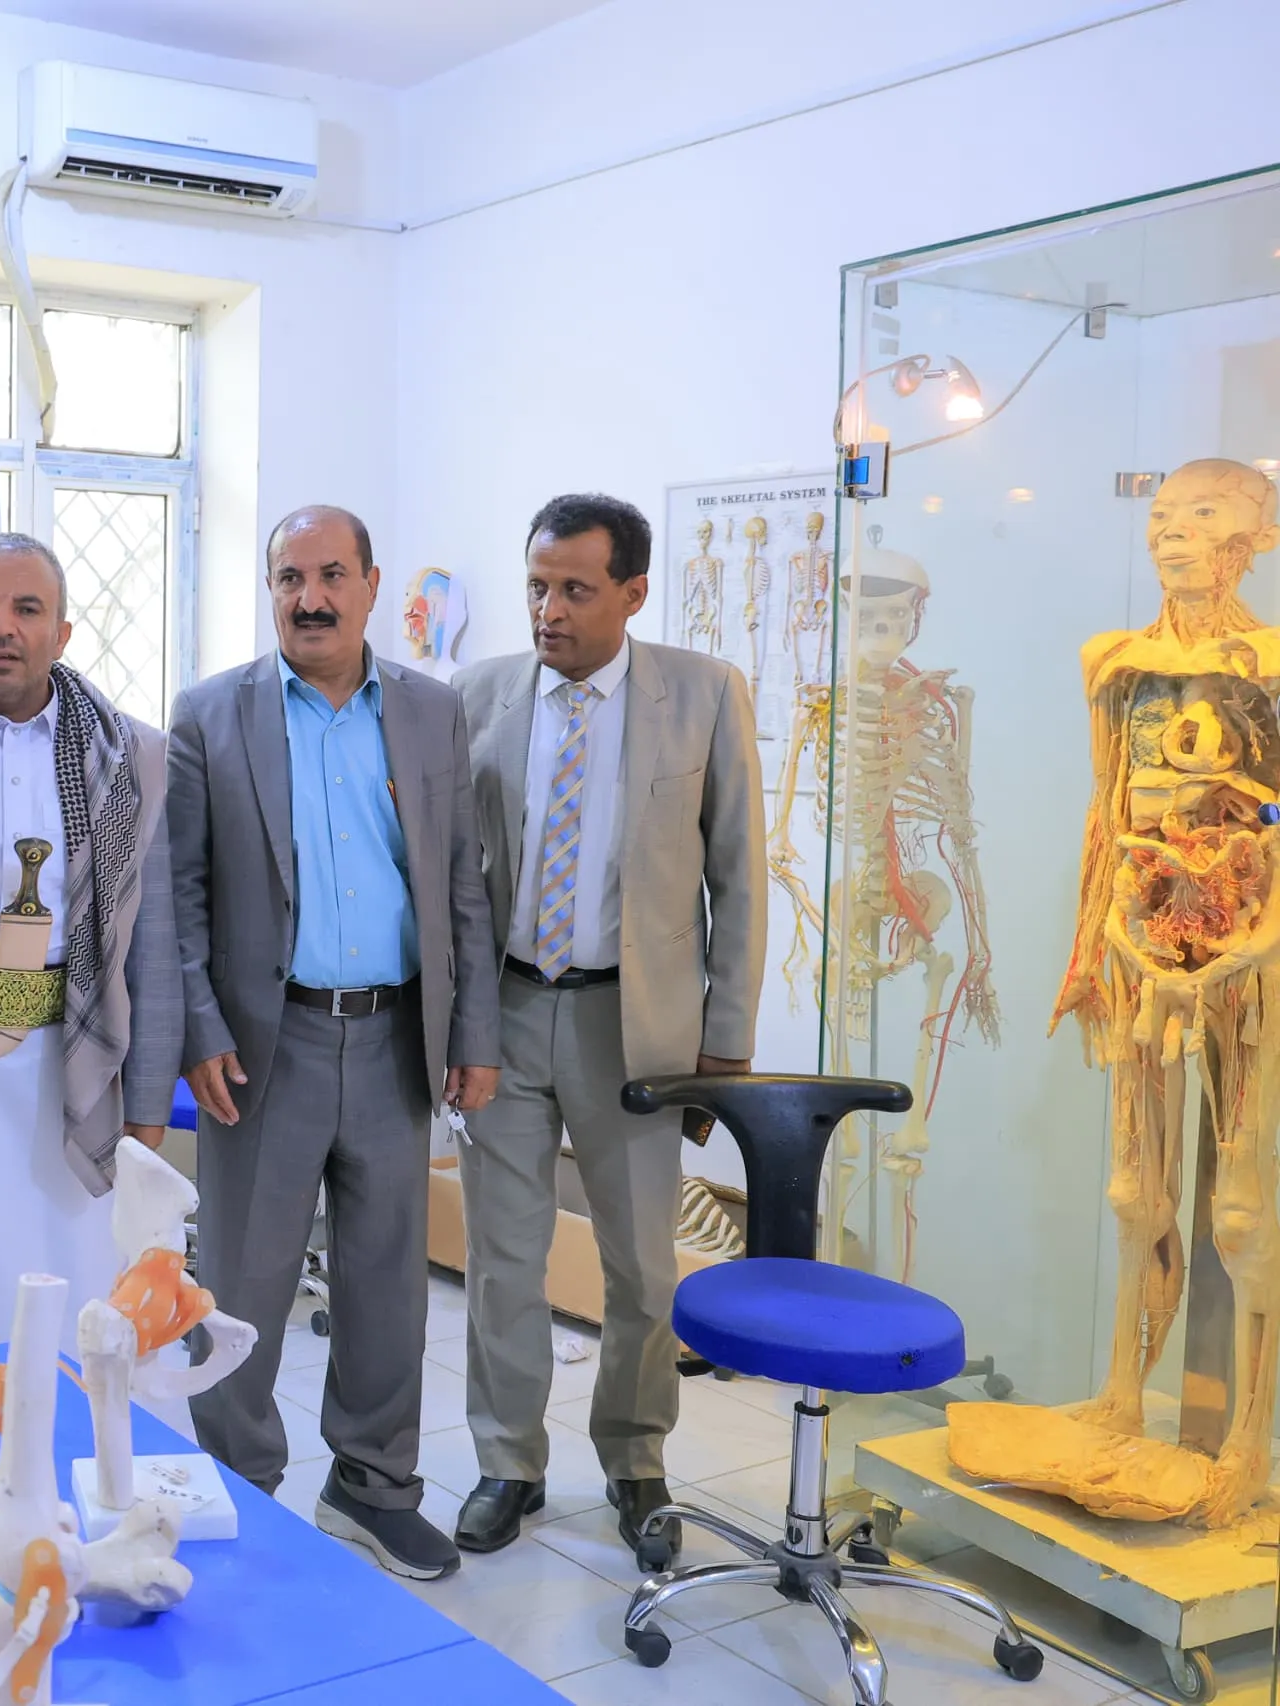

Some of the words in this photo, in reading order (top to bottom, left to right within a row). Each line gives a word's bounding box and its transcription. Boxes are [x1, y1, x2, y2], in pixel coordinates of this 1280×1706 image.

[697, 496, 718, 507] THE
[721, 491, 777, 504] SKELETAL
[779, 487, 827, 500] SYSTEM
